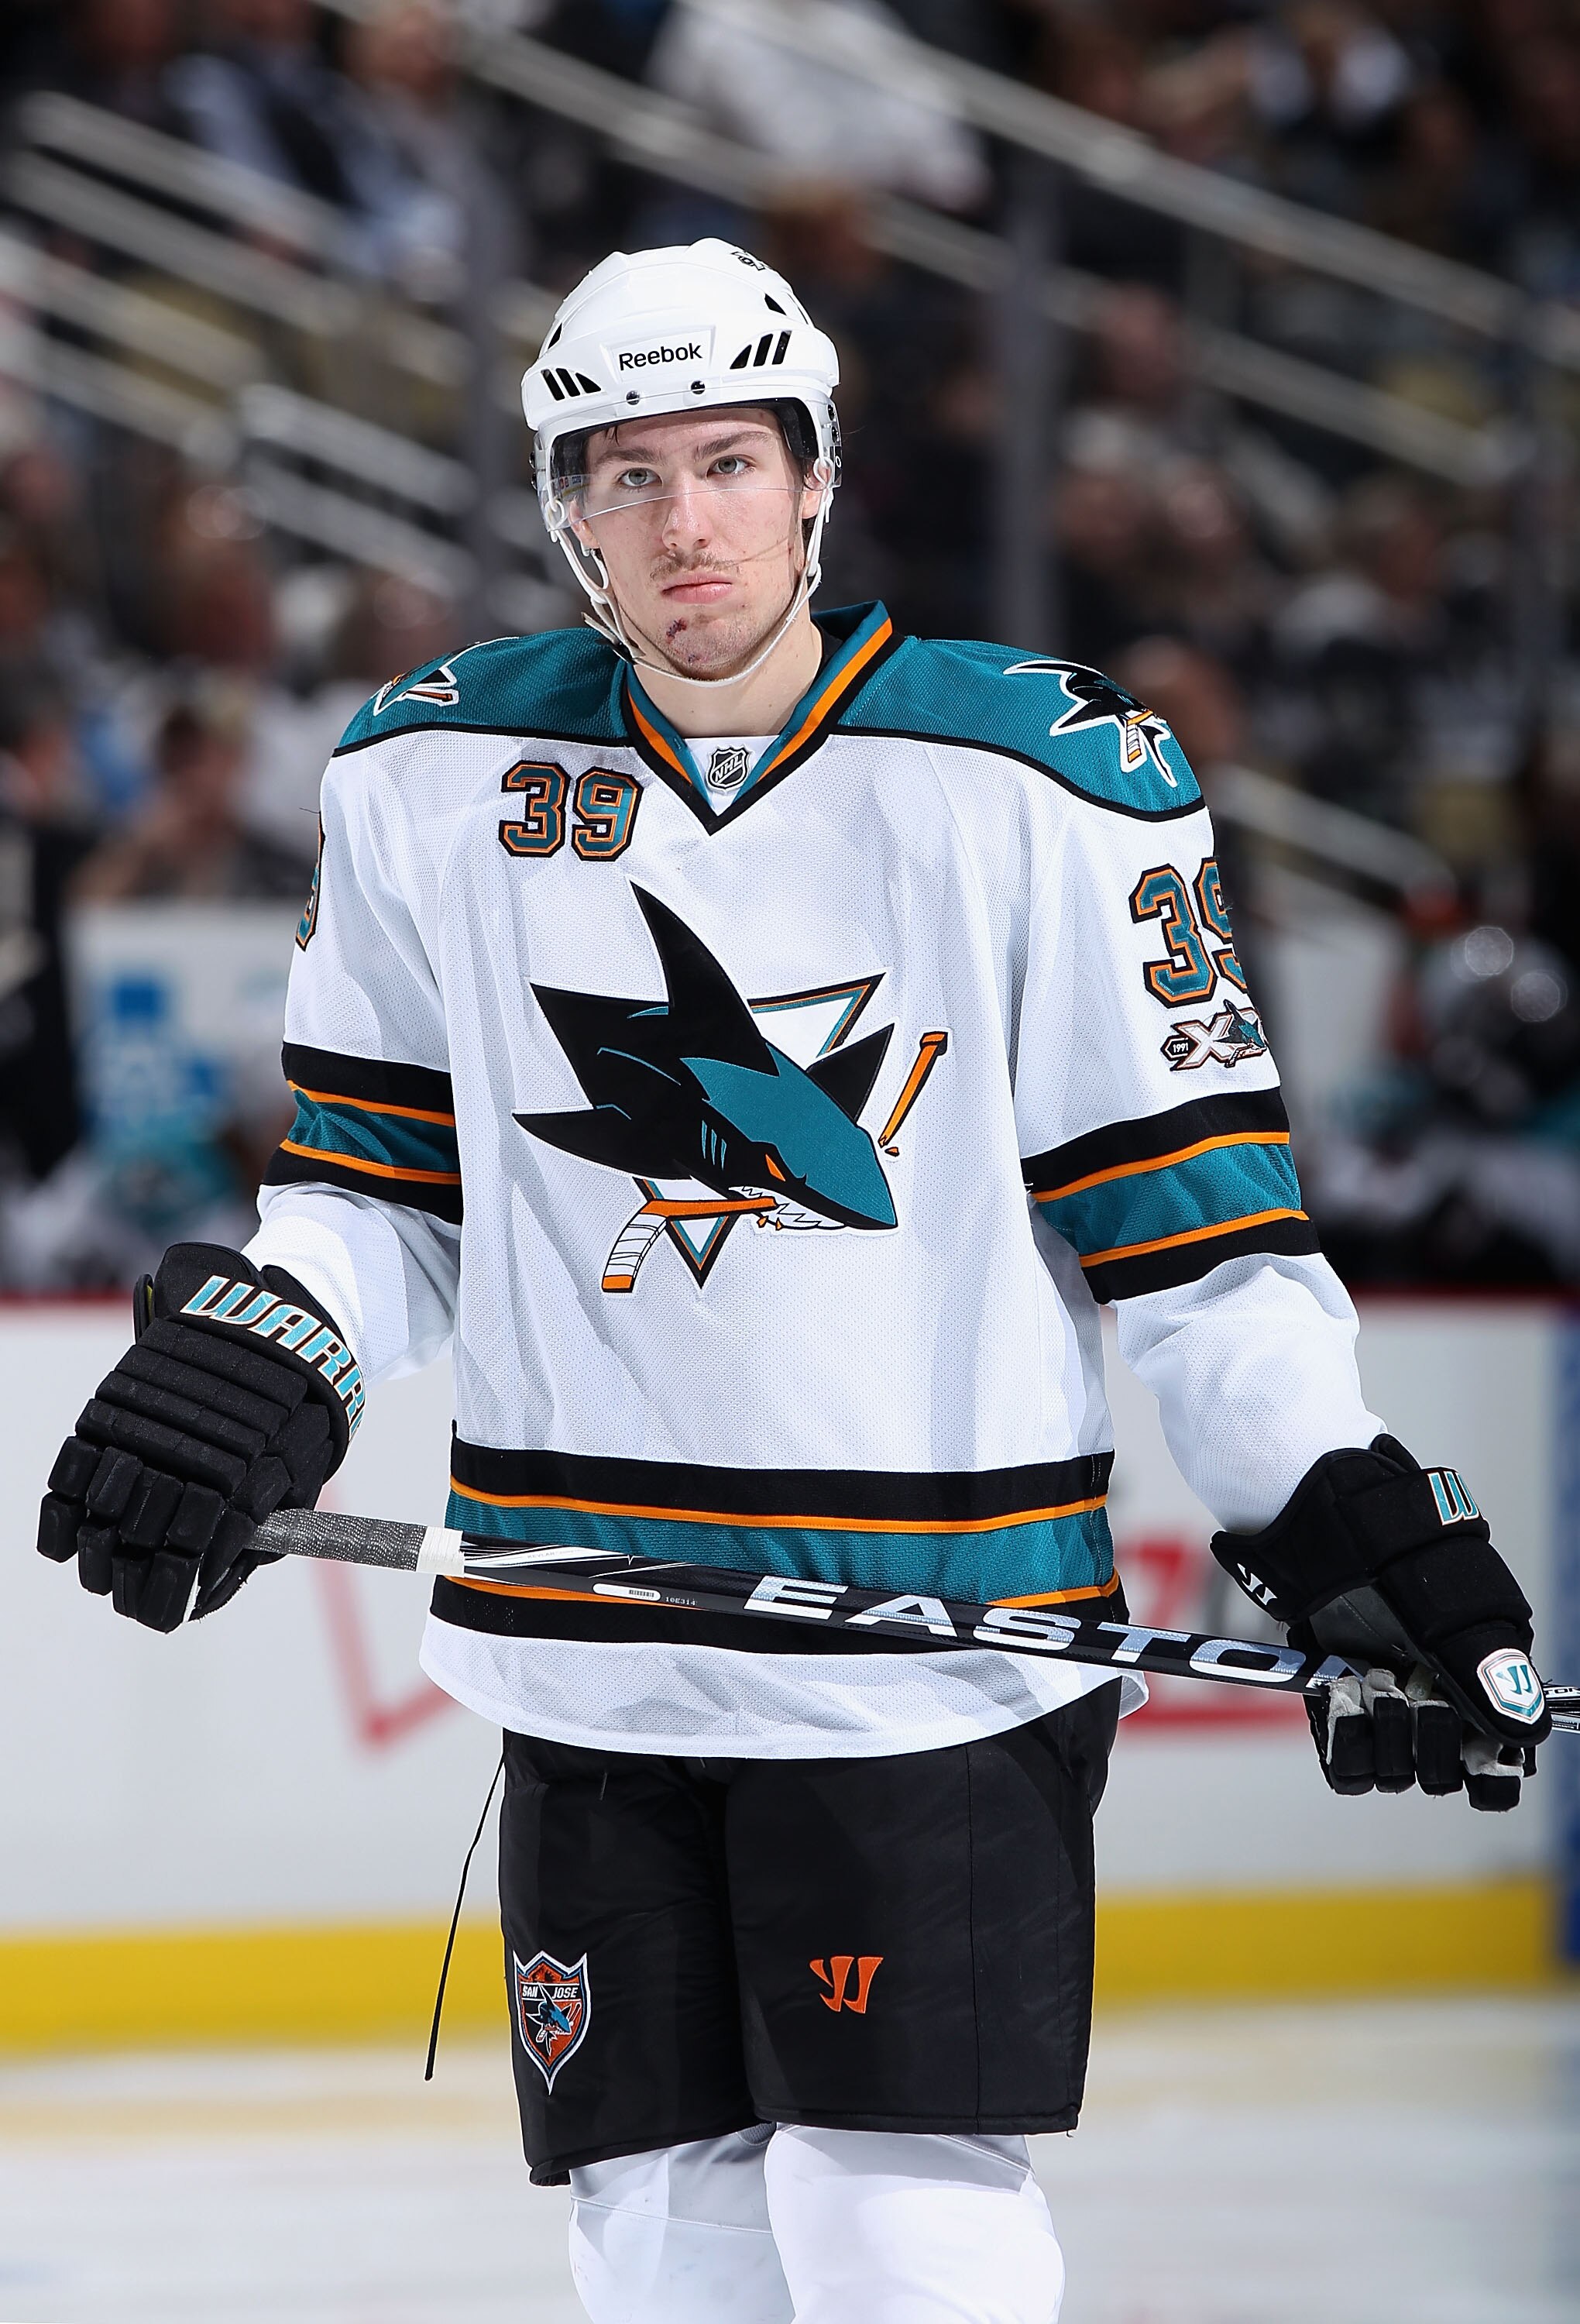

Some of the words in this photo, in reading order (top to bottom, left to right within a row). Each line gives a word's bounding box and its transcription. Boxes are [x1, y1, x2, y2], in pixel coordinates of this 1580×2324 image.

[618, 342, 703, 371] Reebok
[714, 755, 743, 783] NHL
[498, 759, 645, 862] 39
[1173, 1042, 1189, 1054] 1991
[522, 1984, 539, 1998] SAN
[551, 1986, 579, 1999] JOSE
